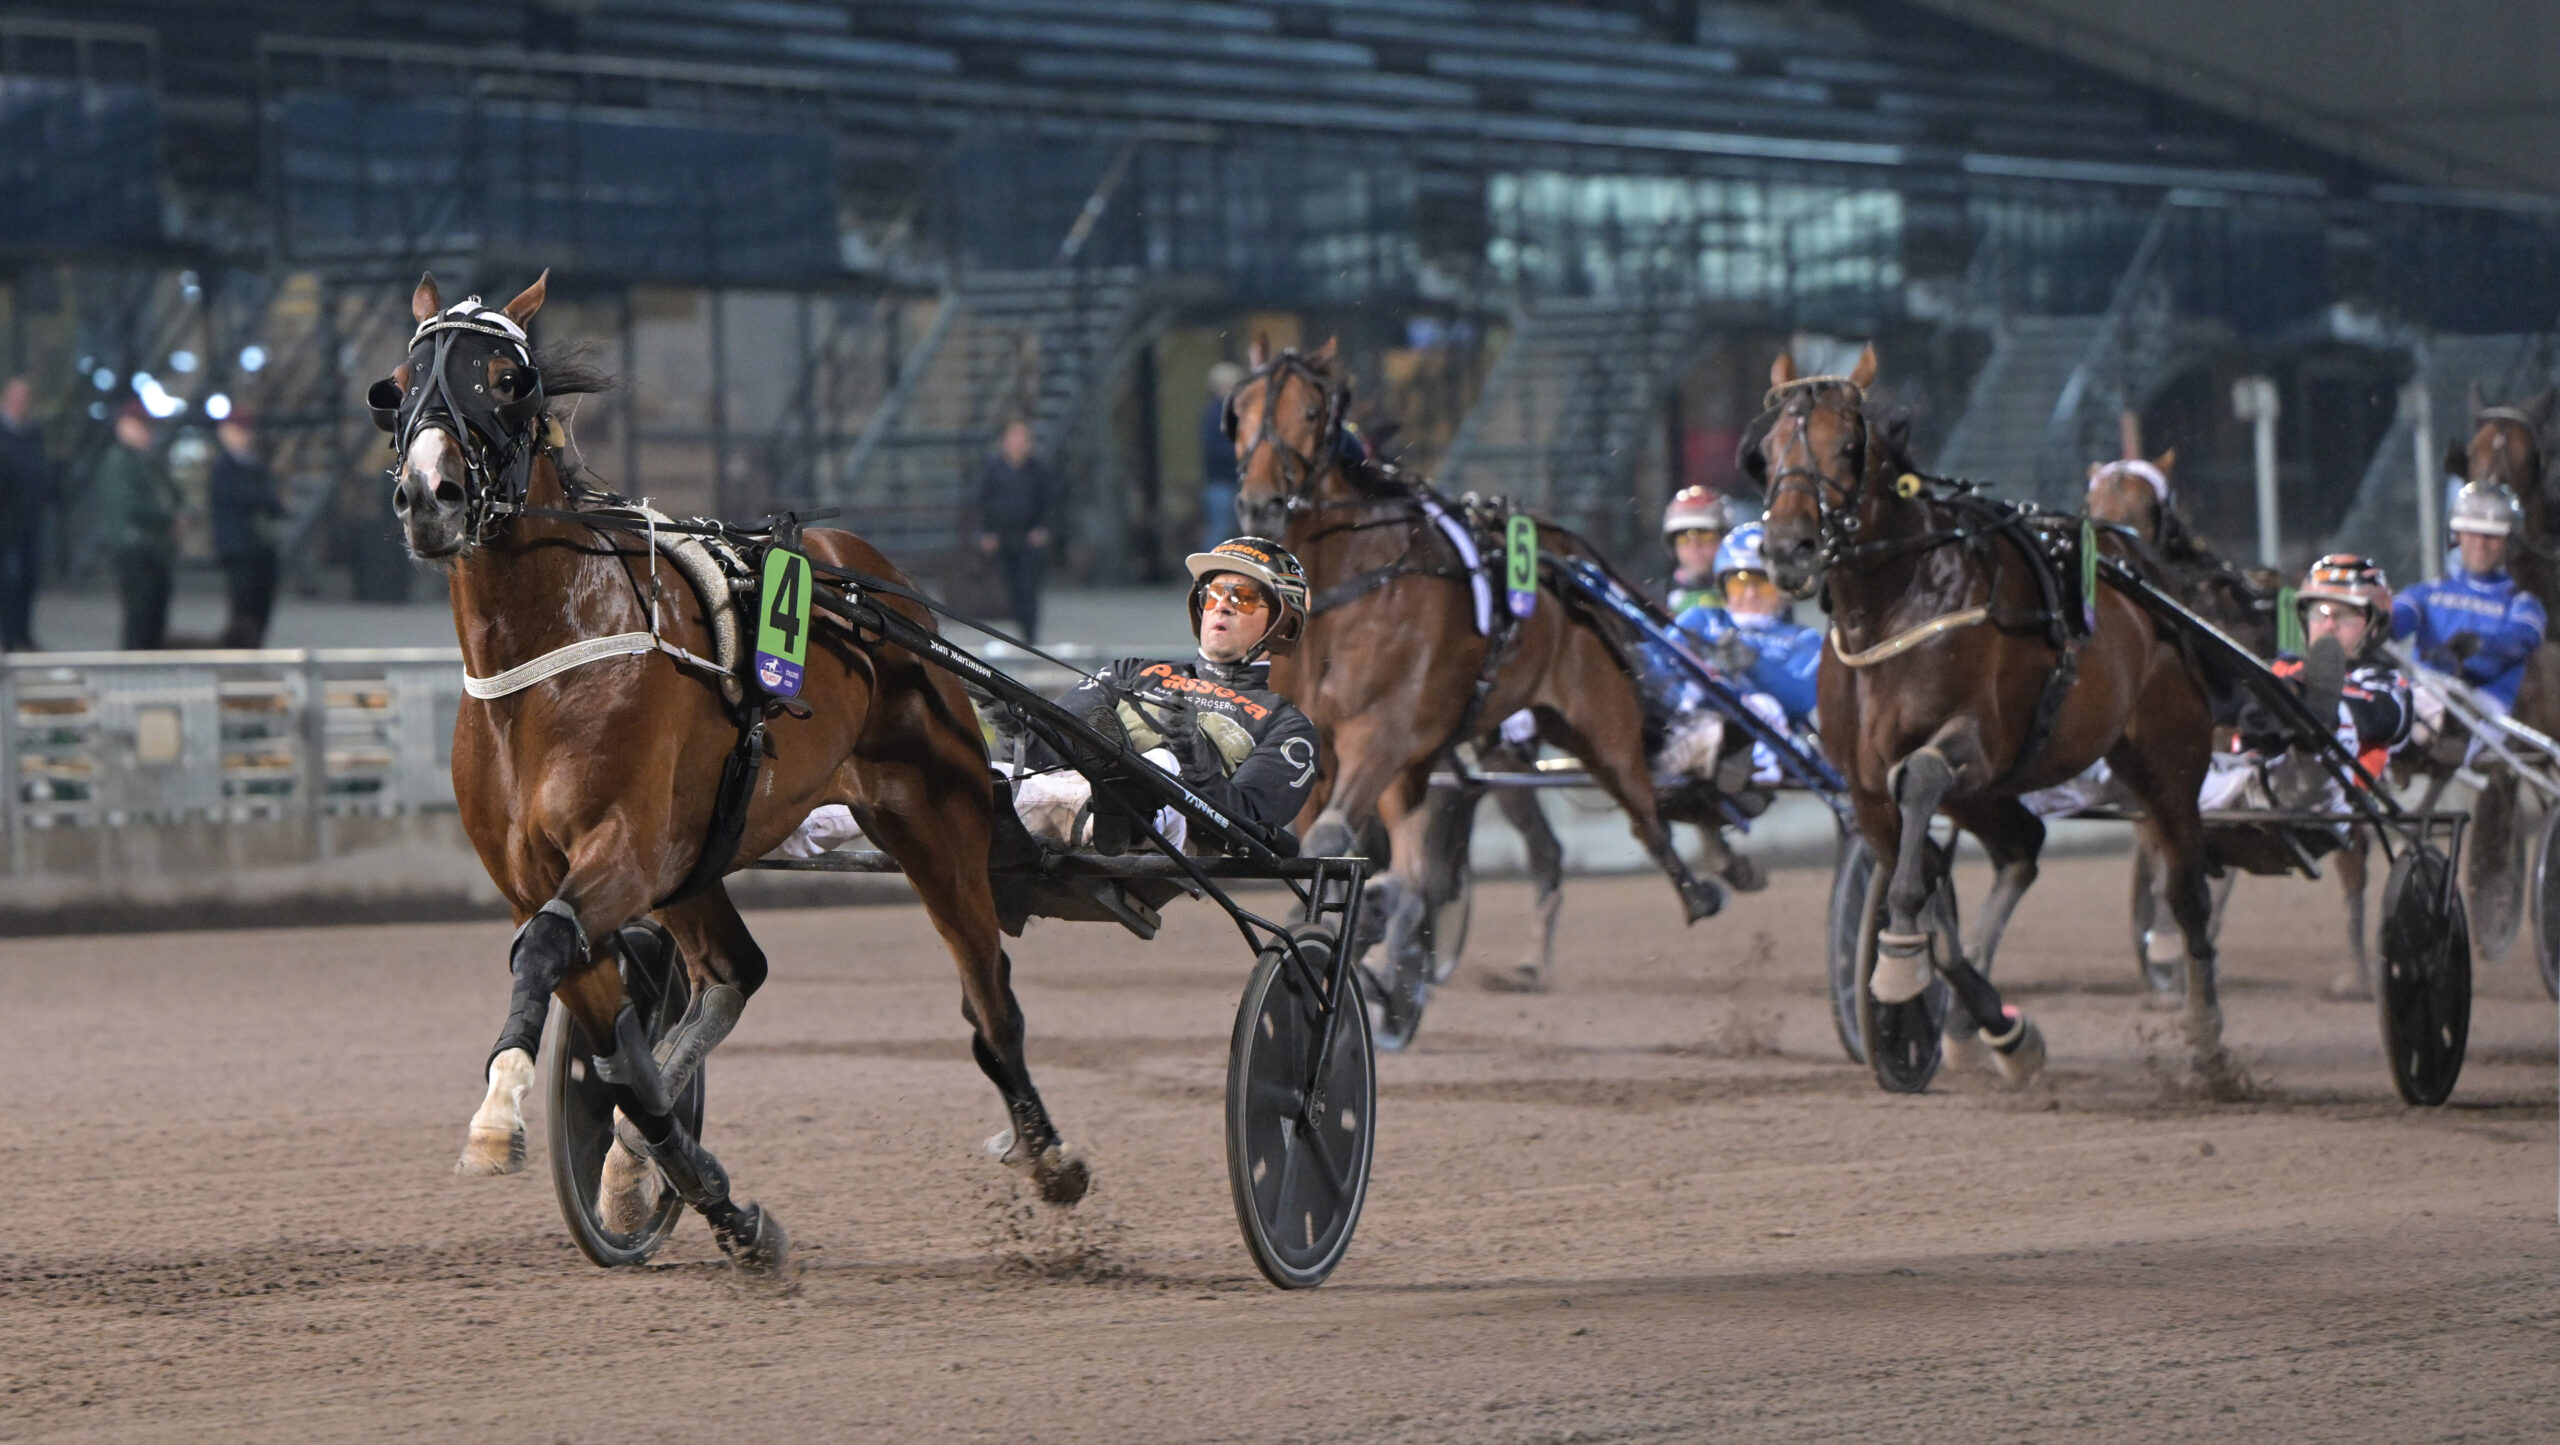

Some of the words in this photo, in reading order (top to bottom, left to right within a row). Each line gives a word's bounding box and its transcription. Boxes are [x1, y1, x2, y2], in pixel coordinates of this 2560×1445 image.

[1515, 522, 1530, 587] 5
[769, 555, 802, 655] 4
[930, 640, 949, 656] Stall
[950, 650, 992, 678] Martinsson
[1139, 663, 1268, 721] Passera
[1195, 696, 1238, 712] PROSERO
[1183, 789, 1230, 829] YANKEE
